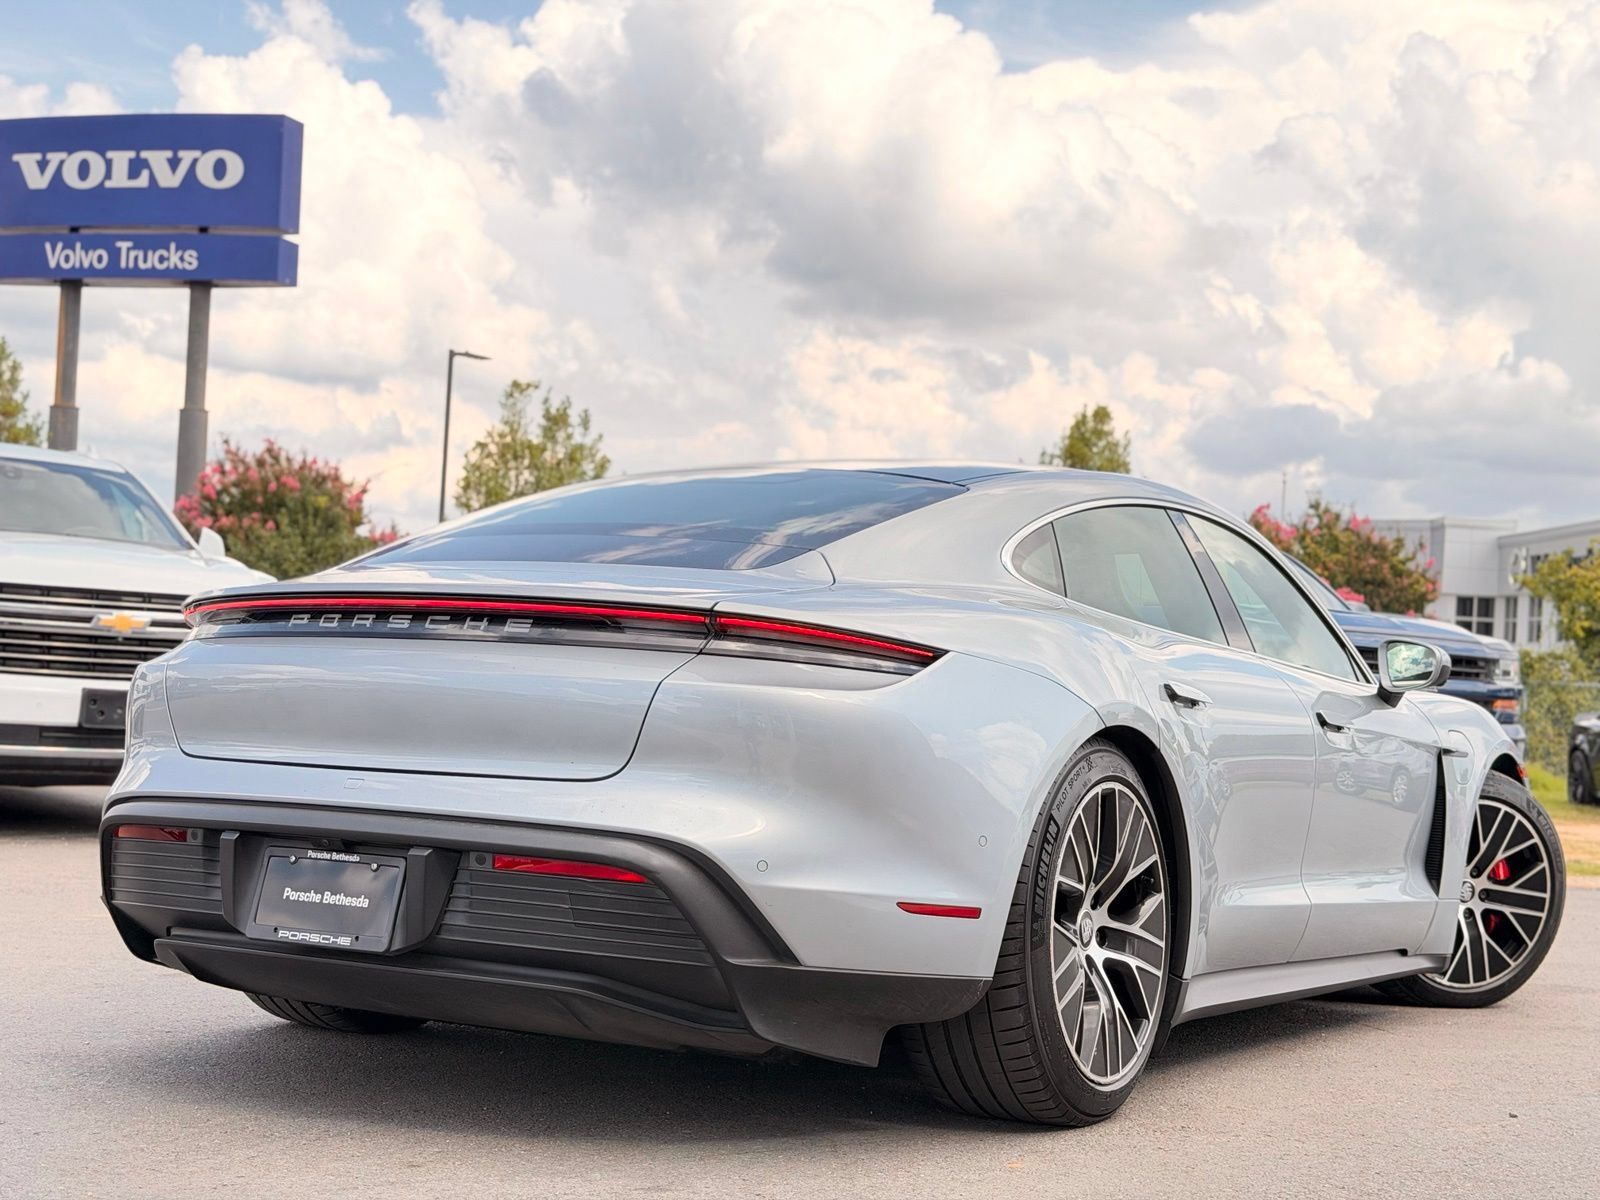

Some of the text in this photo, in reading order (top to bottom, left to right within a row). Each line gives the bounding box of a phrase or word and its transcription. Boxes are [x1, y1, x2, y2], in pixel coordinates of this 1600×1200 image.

[12, 149, 245, 190] VOLVO
[44, 241, 199, 270] Volvo Trucks
[288, 613, 534, 633] PORSCHE
[1055, 767, 1083, 813] PILOT SPORT
[307, 850, 360, 862] Porsche Bethesda
[1034, 819, 1058, 917] MICHELIN
[283, 887, 369, 908] Porsche Bethesda
[278, 930, 352, 946] PORSCHE
